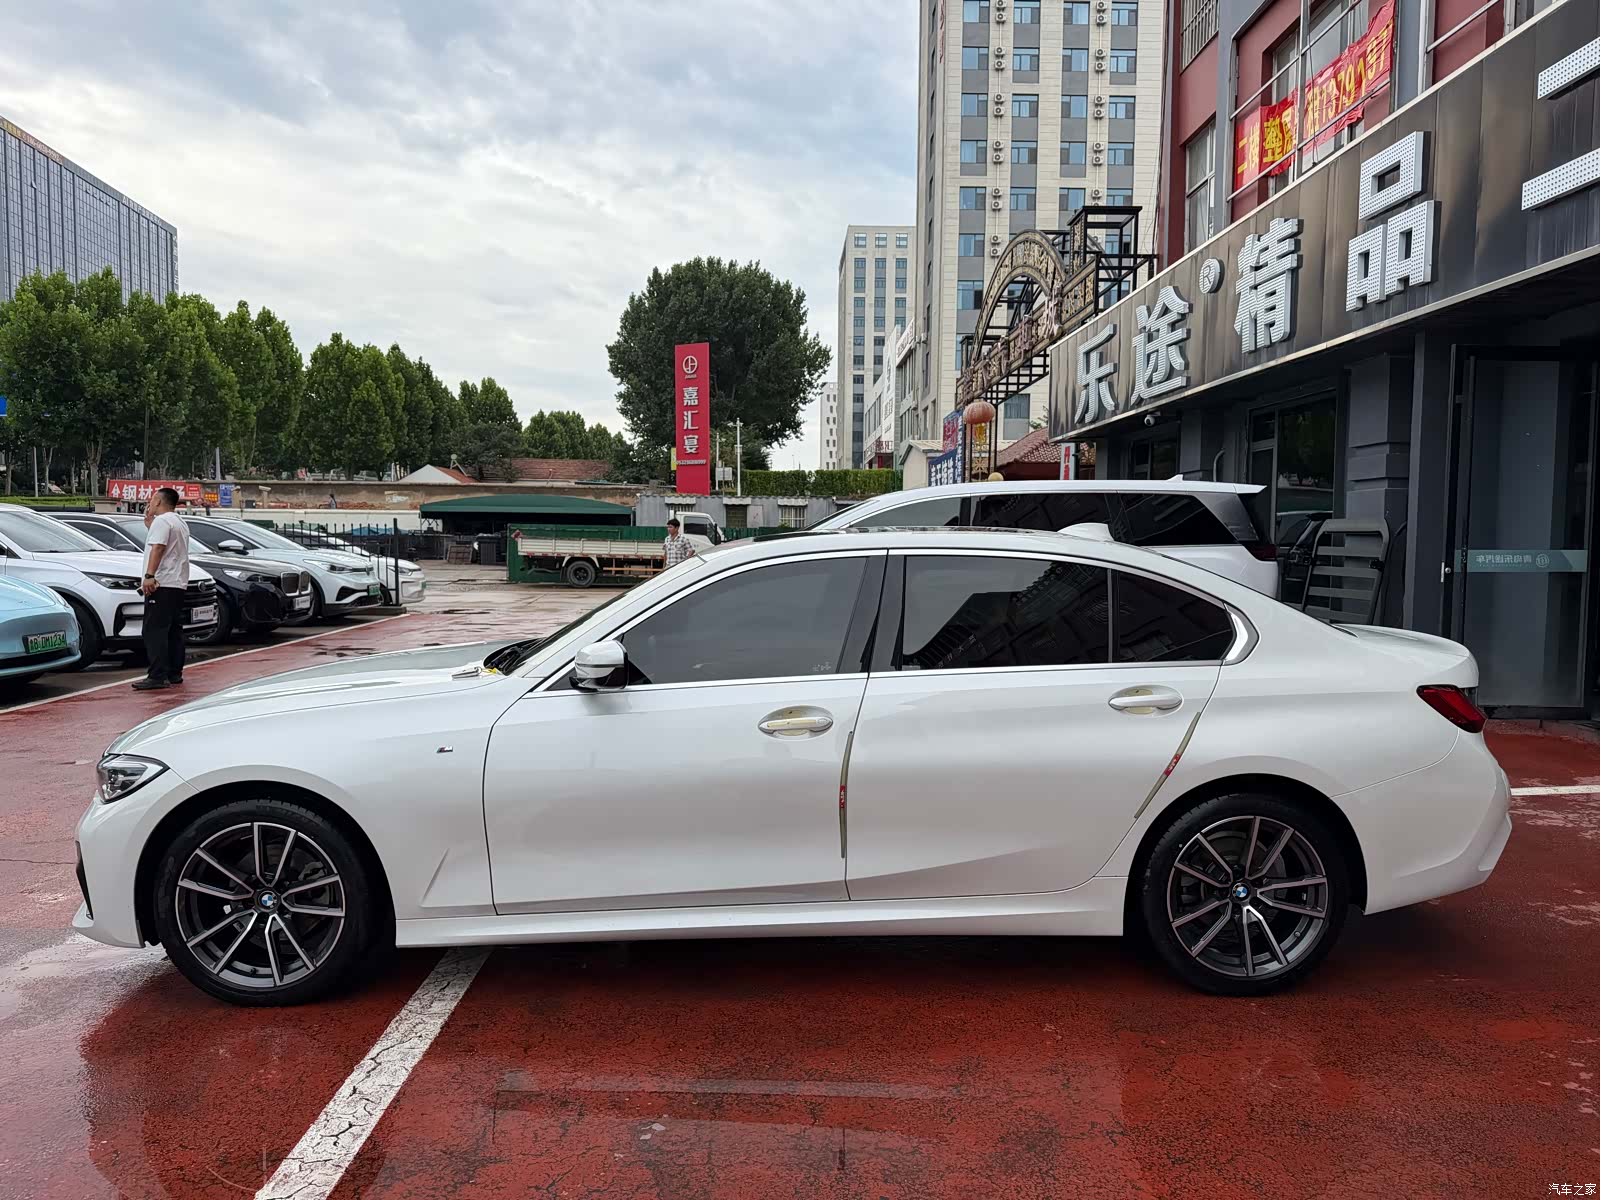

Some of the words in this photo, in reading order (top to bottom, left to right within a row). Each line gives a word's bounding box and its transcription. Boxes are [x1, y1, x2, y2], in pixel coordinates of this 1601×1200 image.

[682, 386, 699, 454] 嘉汇宴
[122, 484, 185, 501] 钢材场
